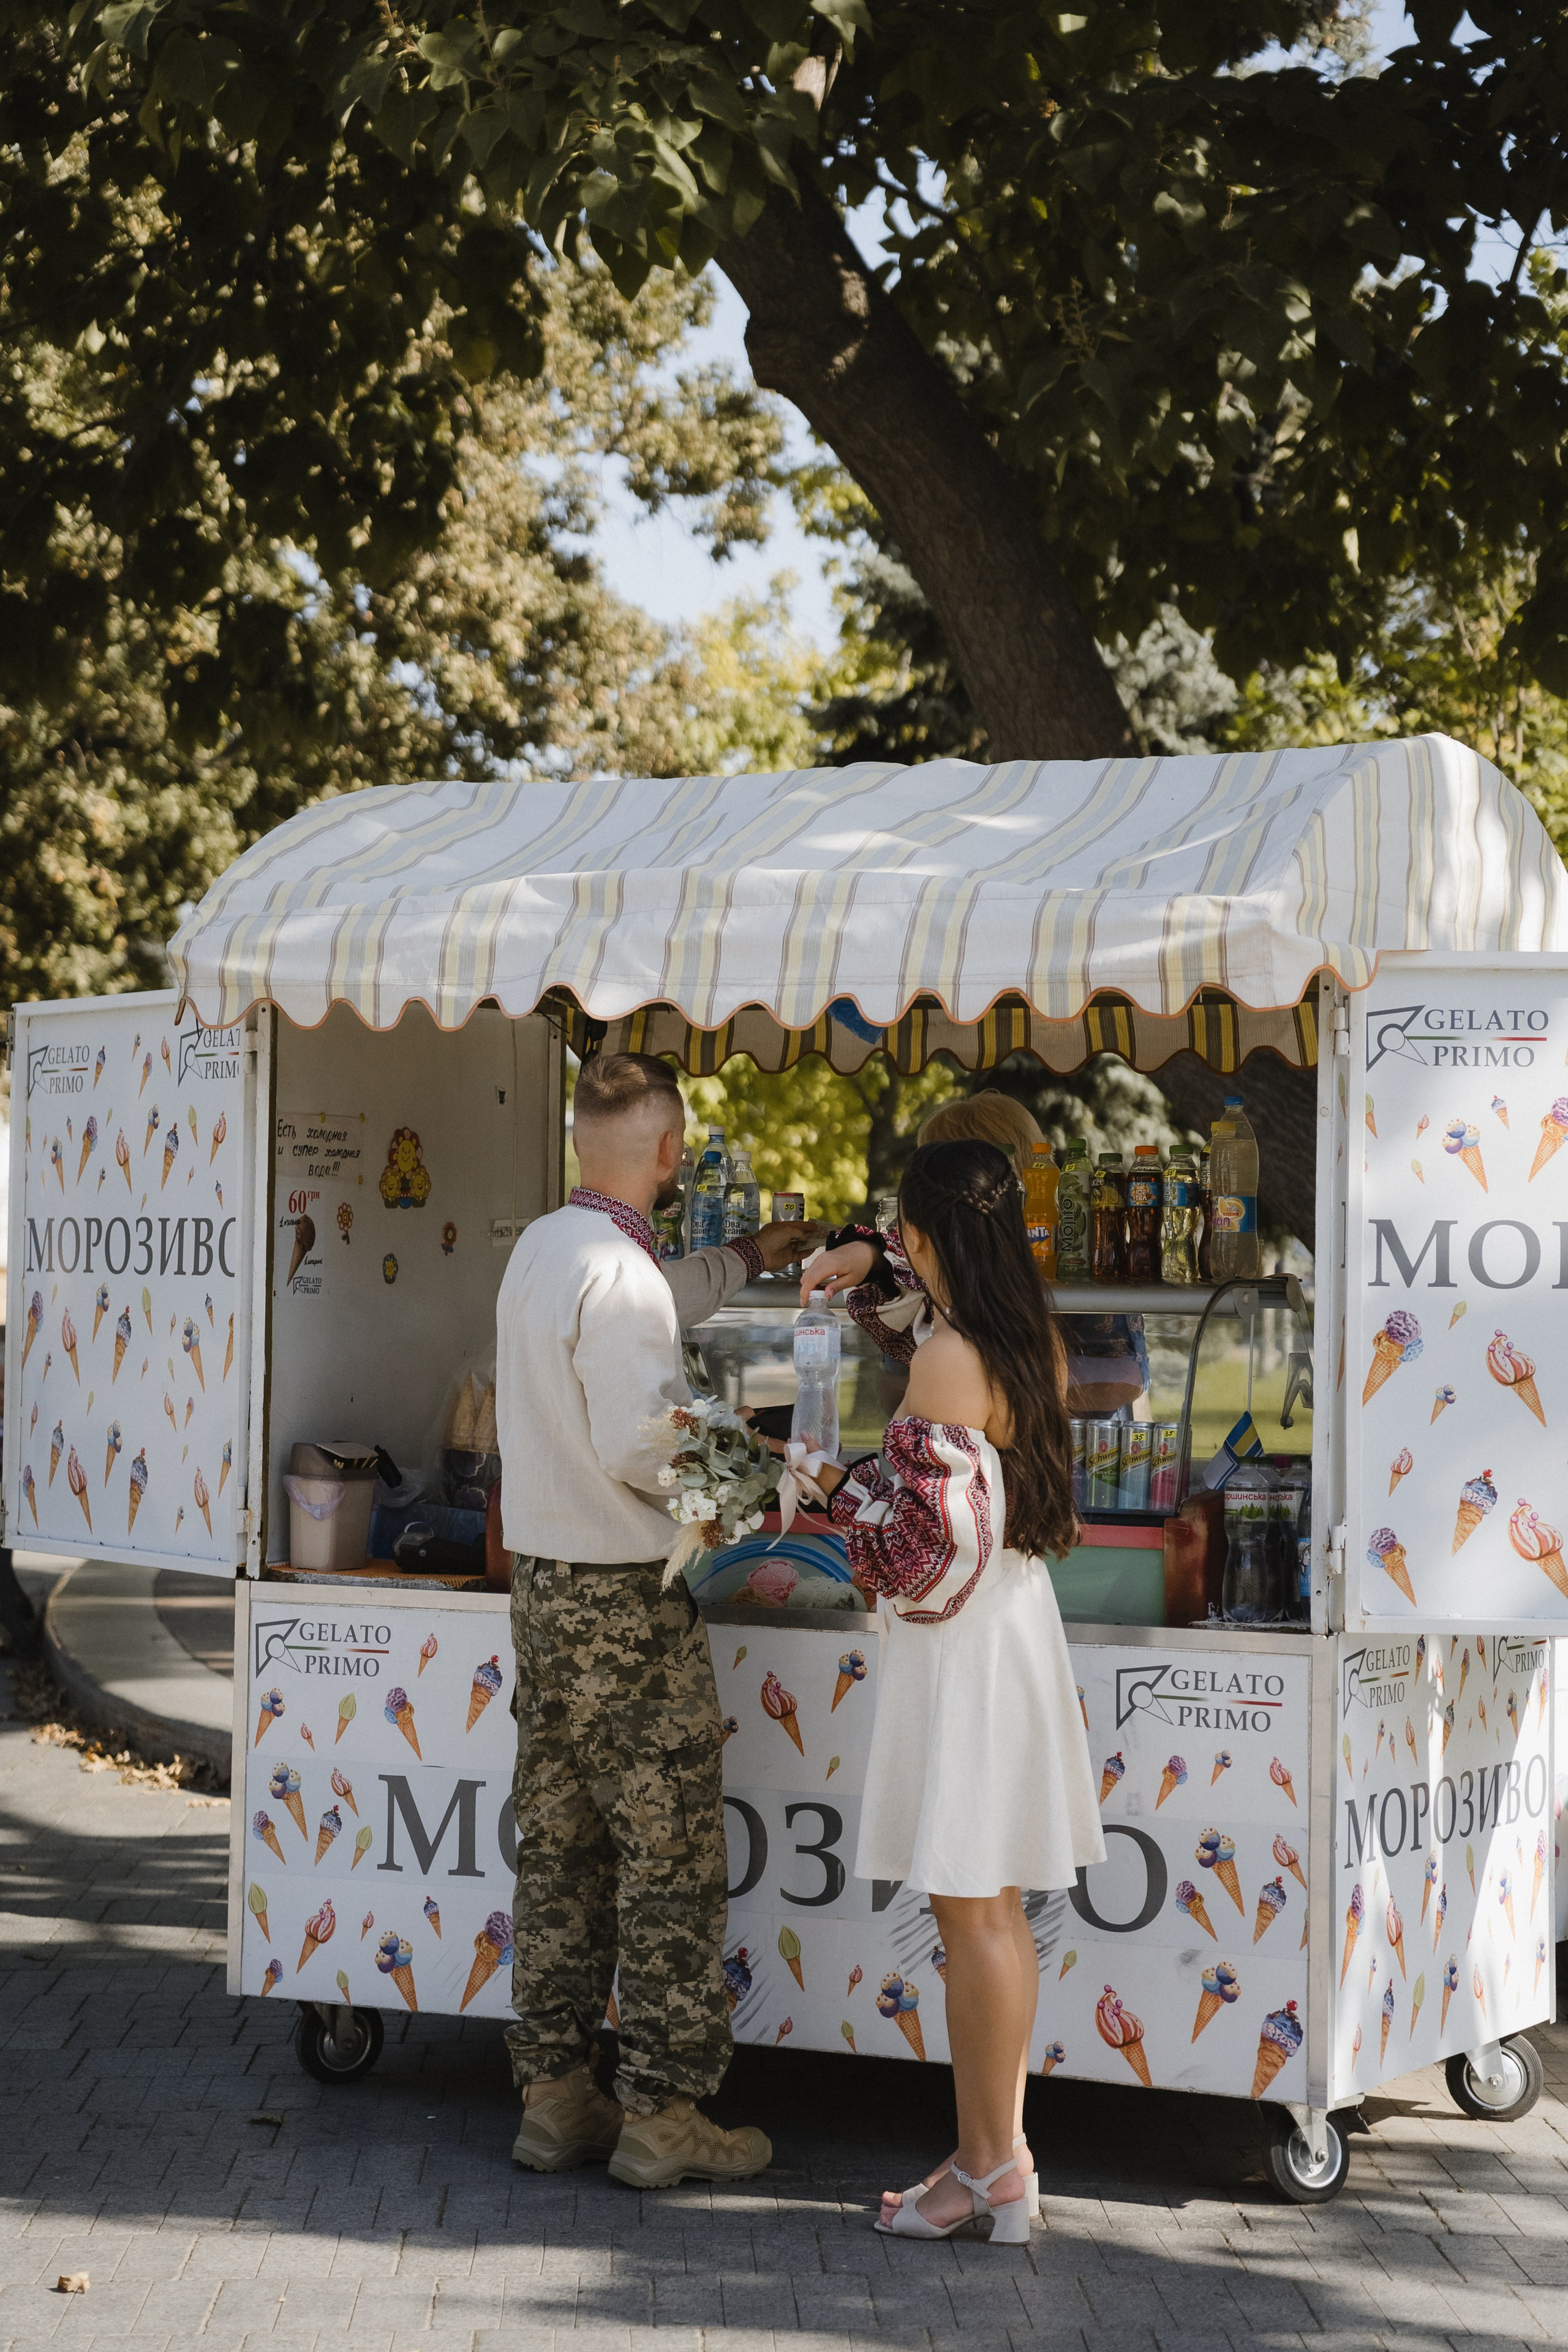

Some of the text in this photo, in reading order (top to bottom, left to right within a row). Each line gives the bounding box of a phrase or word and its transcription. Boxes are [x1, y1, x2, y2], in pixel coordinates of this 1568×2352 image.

[1424, 1009, 1549, 1031] GELATO
[48, 1045, 90, 1065] GELATO
[1433, 1045, 1535, 1068] PRIMO
[205, 1060, 239, 1079] PRIM
[49, 1075, 83, 1094] PRIMO
[277, 1118, 296, 1140] Есть
[277, 1145, 284, 1155] и
[292, 1144, 319, 1157] супер
[288, 1190, 320, 1214] 60 грн
[1027, 1226, 1049, 1238] ANTA
[299, 1622, 391, 1645] GELATO
[304, 1655, 380, 1677] PRIMO
[1366, 1645, 1410, 1672] GELATO
[1515, 1649, 1545, 1673] PRIMO
[1171, 1669, 1284, 1696] GELATO
[1370, 1682, 1404, 1708] PRIMO
[1178, 1706, 1271, 1732] PRIMO
[1344, 1754, 1547, 1869] МОРОЗИВО
